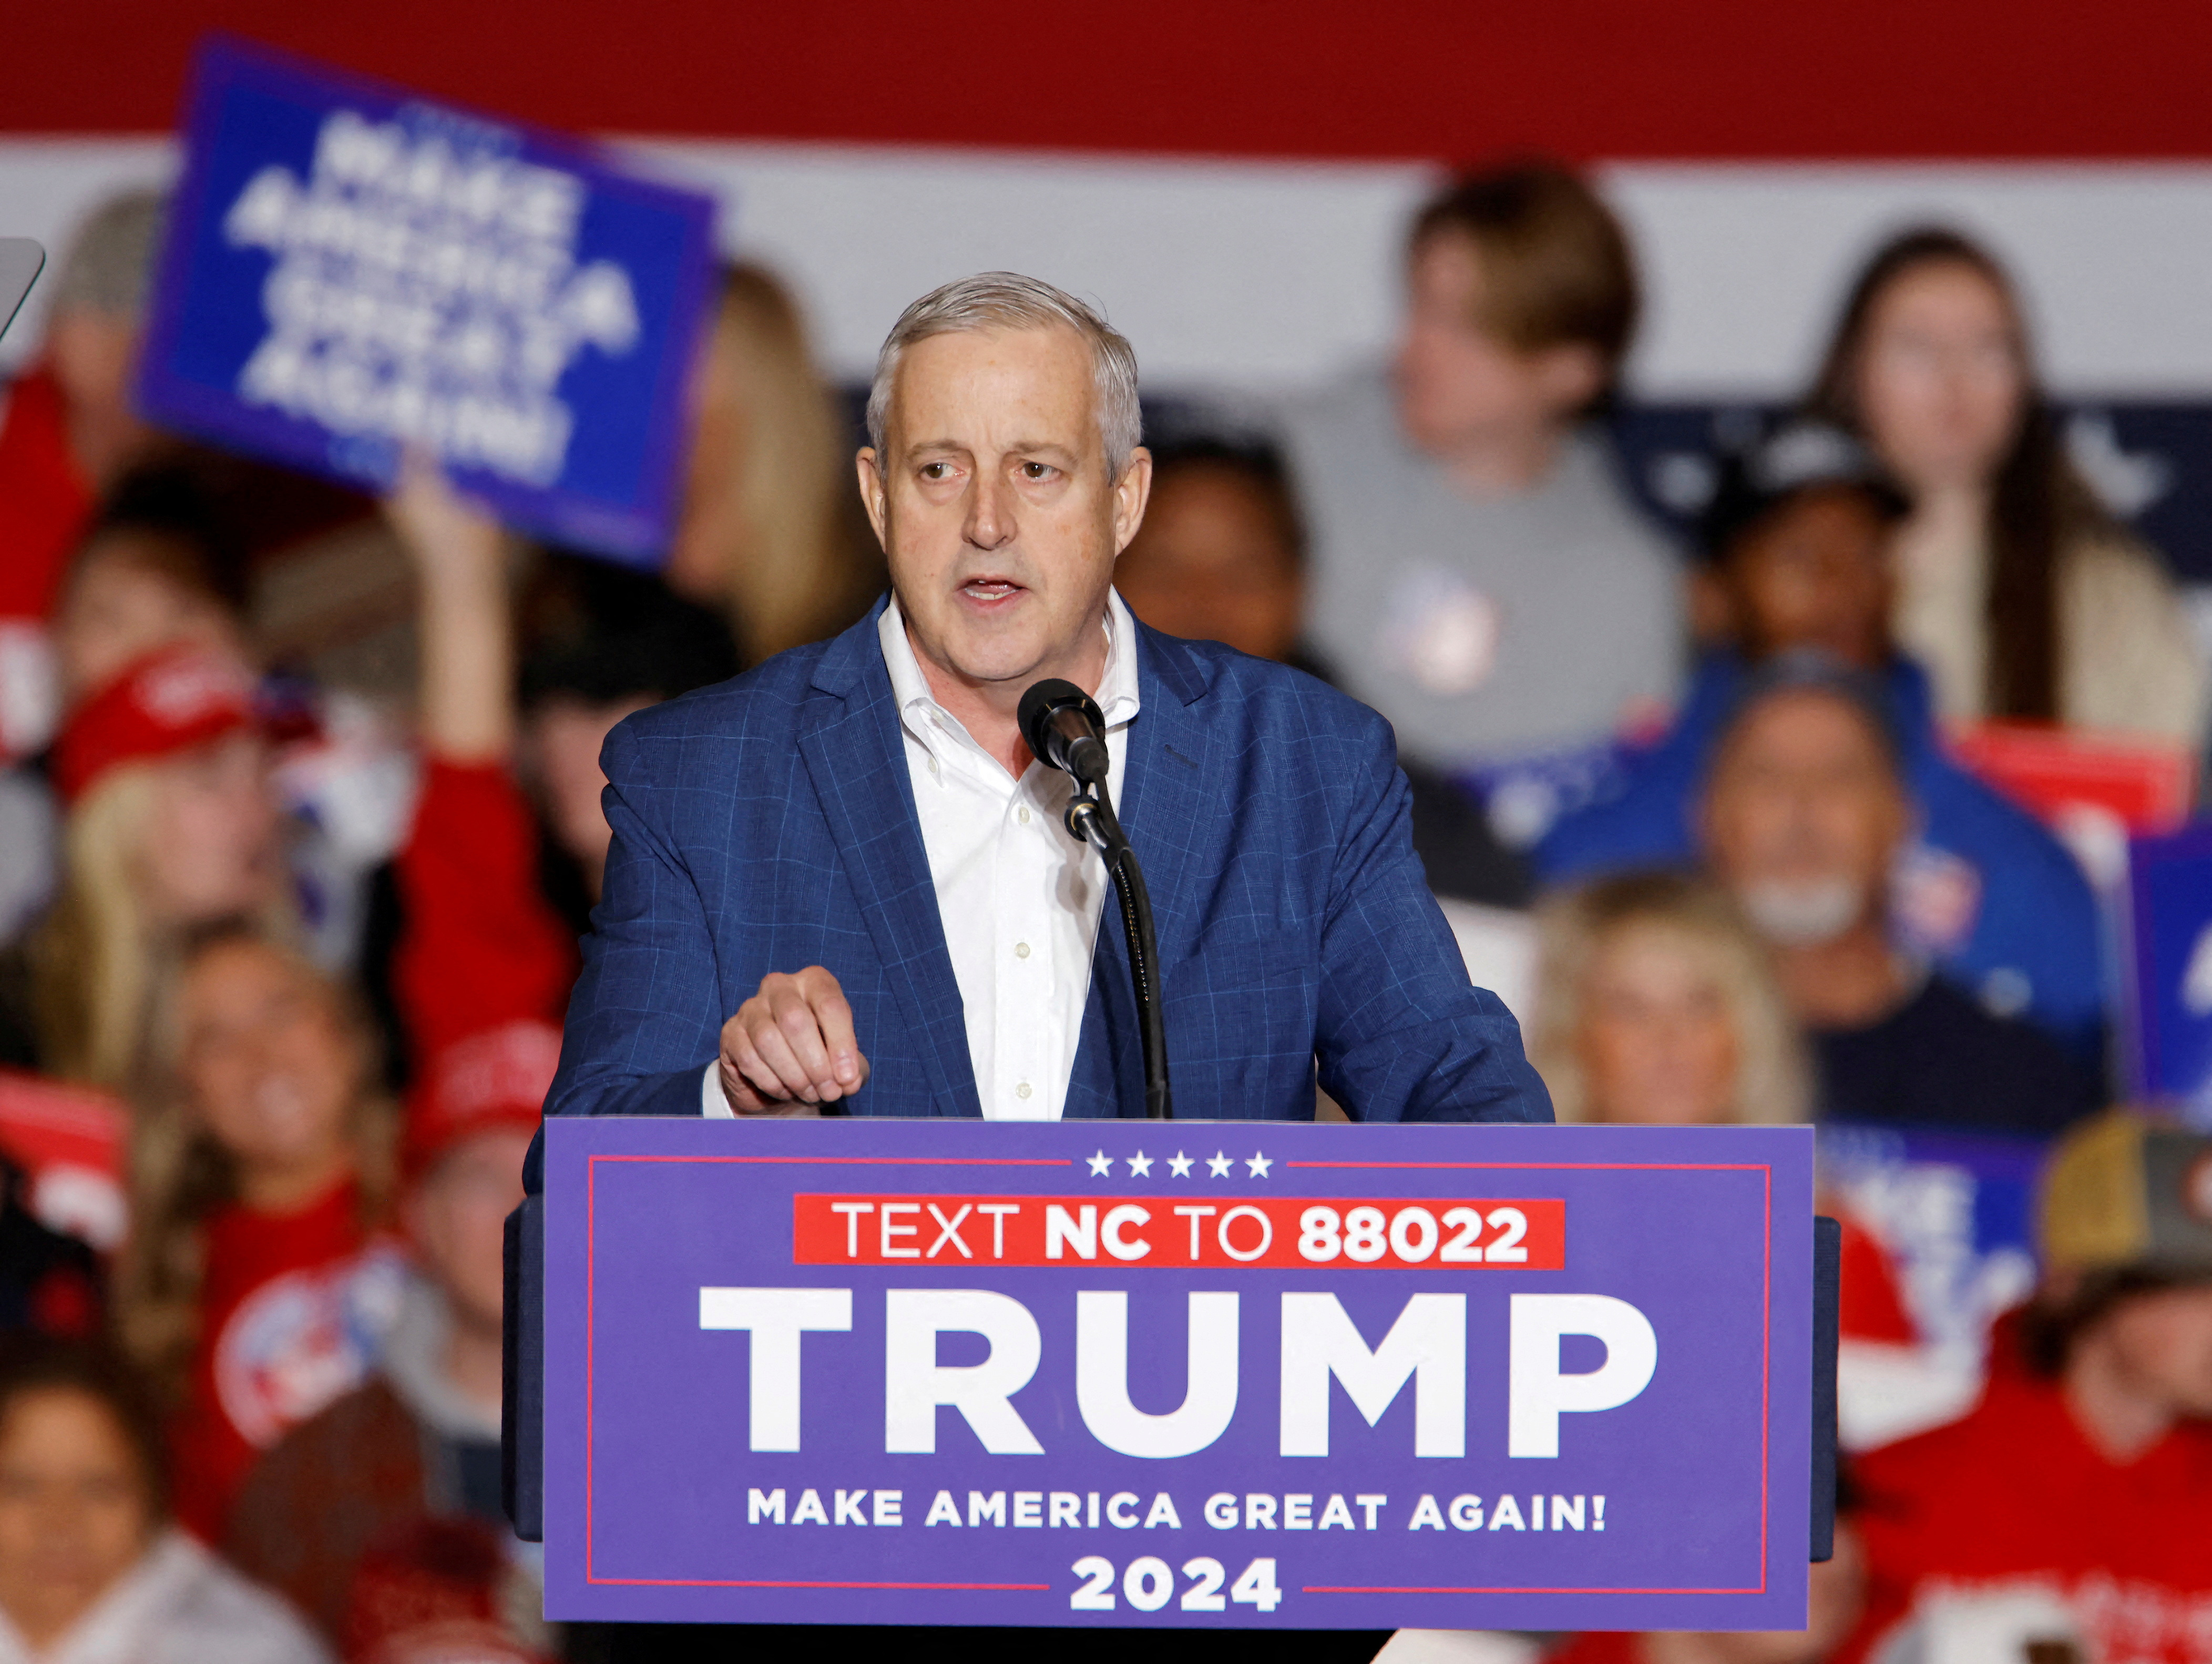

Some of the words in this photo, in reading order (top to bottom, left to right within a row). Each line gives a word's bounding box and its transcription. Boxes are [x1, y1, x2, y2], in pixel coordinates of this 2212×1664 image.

[831, 1202, 1021, 1259] TEXT
[1045, 1204, 1151, 1261] NC
[1173, 1205, 1273, 1262] TO
[1297, 1206, 1528, 1263] 88022
[699, 1286, 1658, 1459] TRUMP
[747, 1488, 903, 1527] MAKE
[924, 1489, 1182, 1529] AMERICA
[1203, 1492, 1388, 1531] GREAT
[1408, 1494, 1606, 1532] AGAIN!
[1070, 1556, 1283, 1612] 2024
